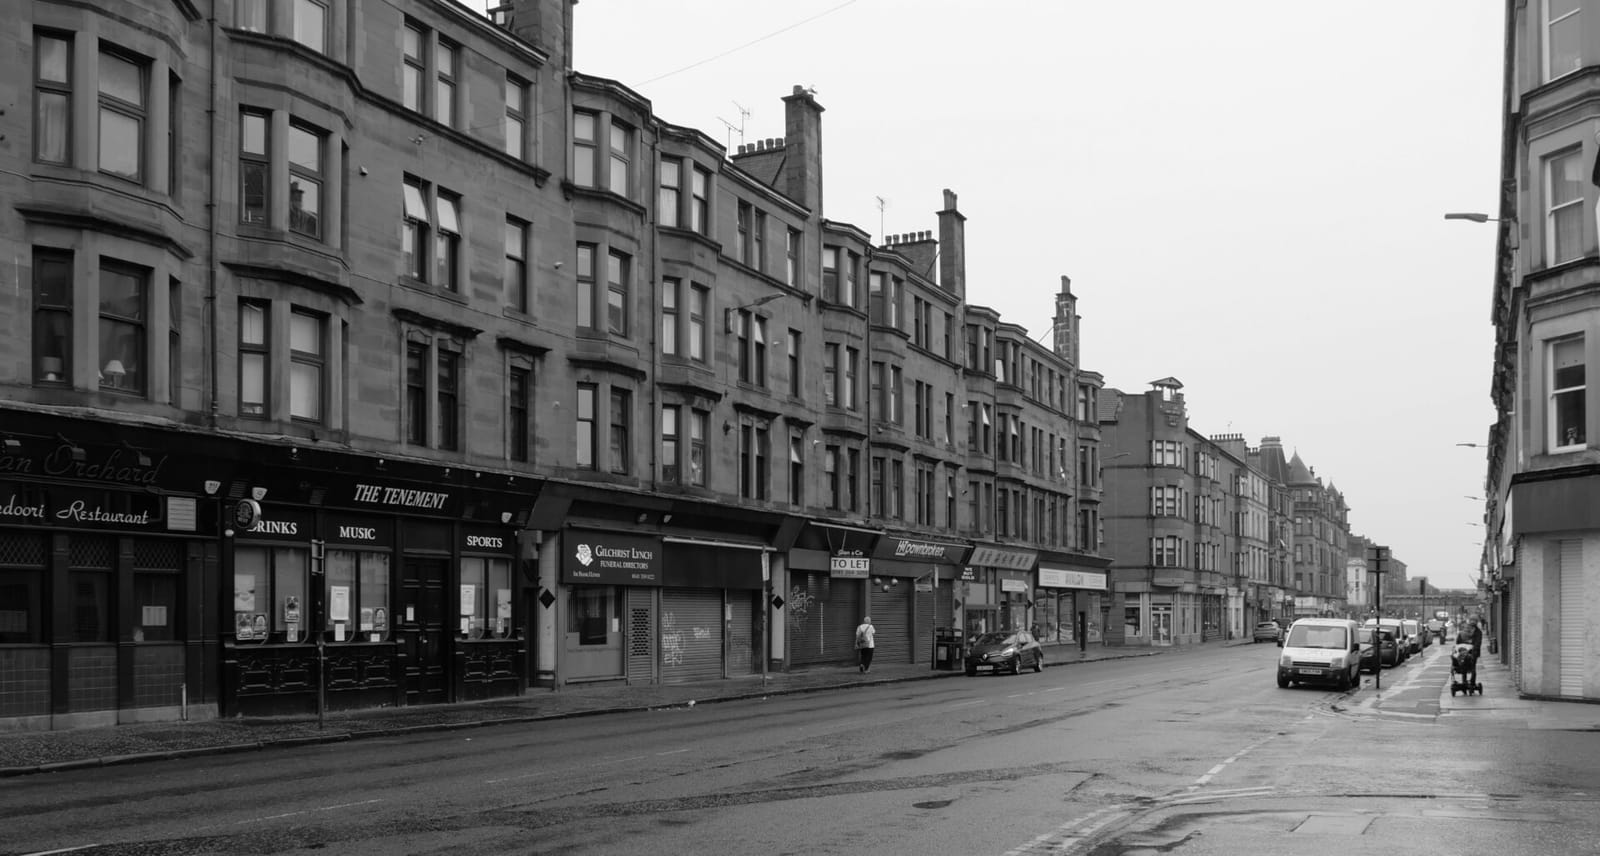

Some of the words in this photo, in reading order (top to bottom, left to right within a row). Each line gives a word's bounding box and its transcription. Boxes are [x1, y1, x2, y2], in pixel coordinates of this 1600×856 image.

[44, 444, 168, 484] Orchard
[353, 484, 382, 503] THE
[382, 487, 449, 510] TENEMENT
[0, 494, 45, 518] doori
[56, 500, 149, 525] Restaurant
[247, 520, 297, 535] RINKS
[339, 526, 376, 540] MUSIC
[466, 535, 503, 548] SPORTS
[600, 560, 622, 569] FUNERAL
[622, 561, 648, 570] DIRECTORS
[832, 559, 847, 569] TO
[850, 559, 869, 569] LET
